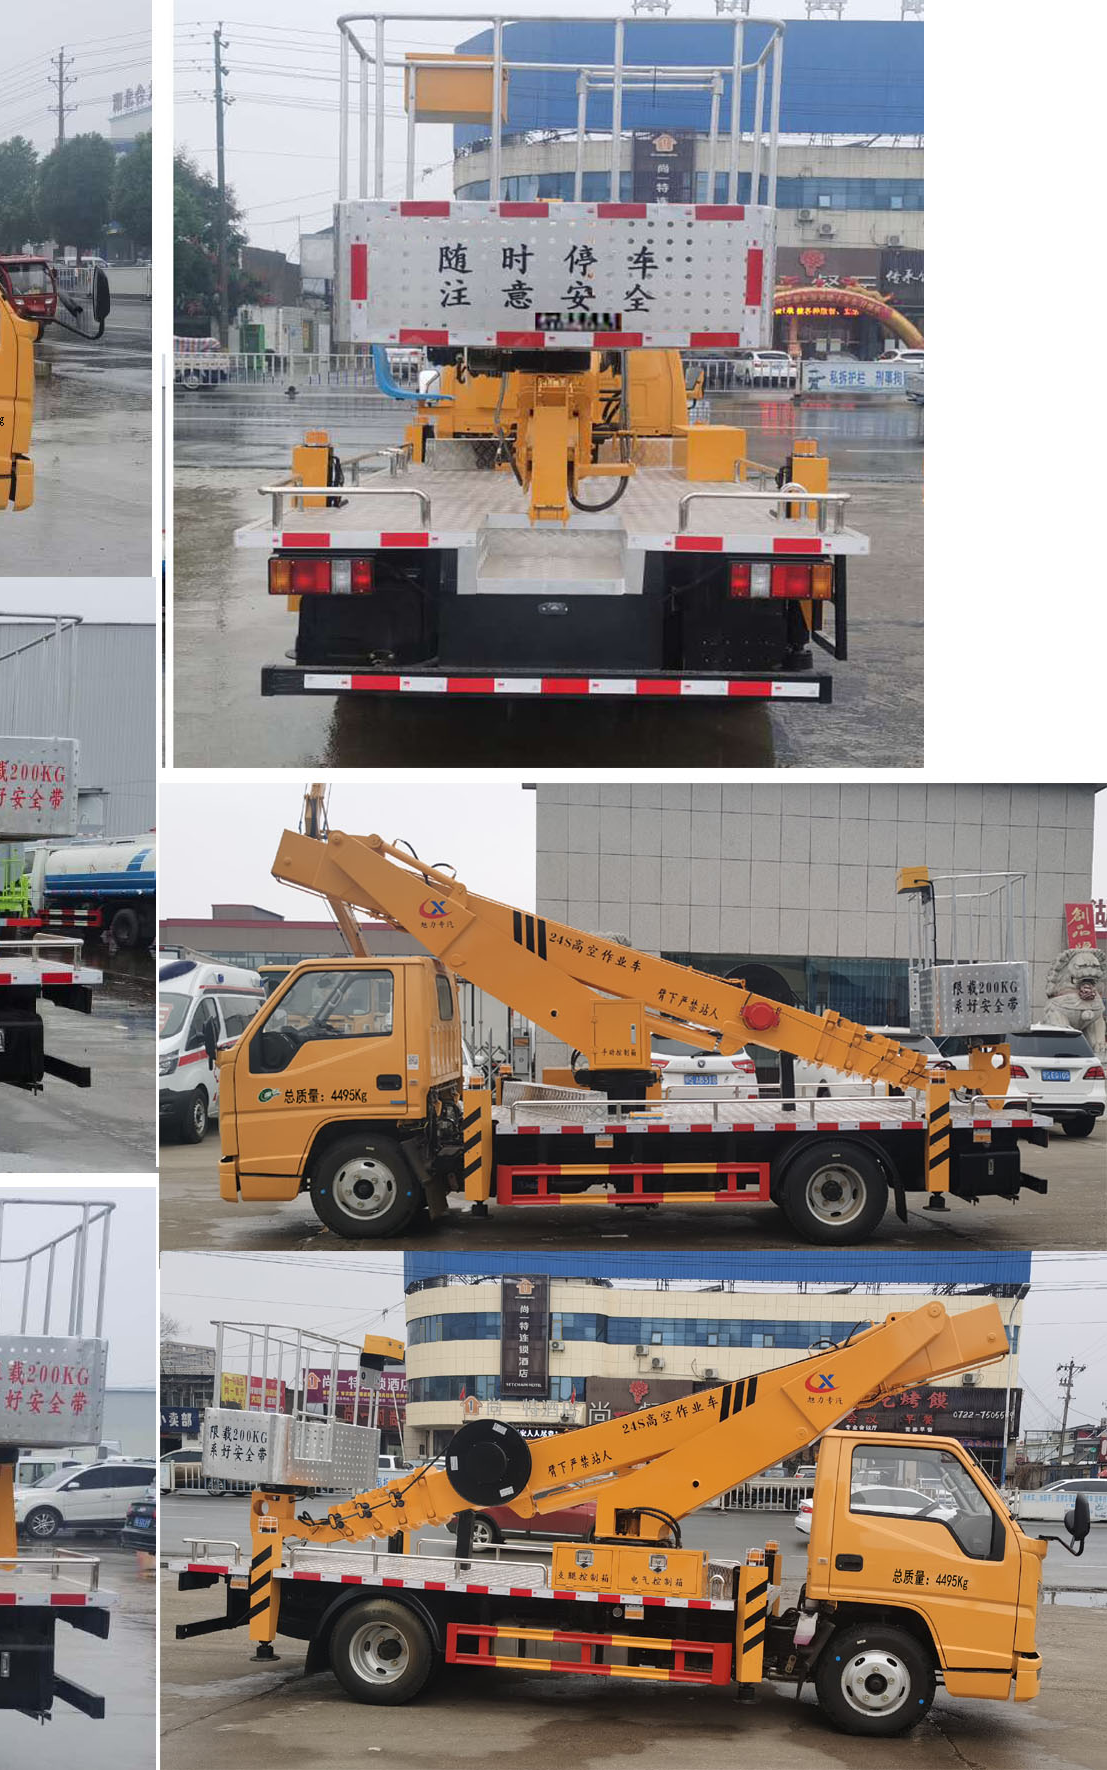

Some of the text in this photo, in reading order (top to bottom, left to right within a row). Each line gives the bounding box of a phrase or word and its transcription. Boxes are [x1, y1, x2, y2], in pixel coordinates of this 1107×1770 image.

[438, 243, 659, 280] 随时停车
[440, 279, 656, 313] 注意安全
[549, 932, 642, 973] 24S高空作业车
[952, 980, 1018, 996] 限载200KG
[657, 988, 719, 1020] 臂下严禁站人
[954, 997, 1019, 1014] 系好安全带
[518, 1305, 530, 1378] 尚一特连锁酒店
[621, 1395, 719, 1434] 24S高空作业车
[847, 1411, 878, 1424] 会议
[953, 1410, 1013, 1422] 0722-750559
[209, 1425, 268, 1443] 限载200KG
[209, 1443, 268, 1463] 系好安全带
[547, 1449, 613, 1478] 臂下严禁站人
[557, 1570, 609, 1583] 支腿控制箱
[631, 1575, 683, 1588] 电气控制箱
